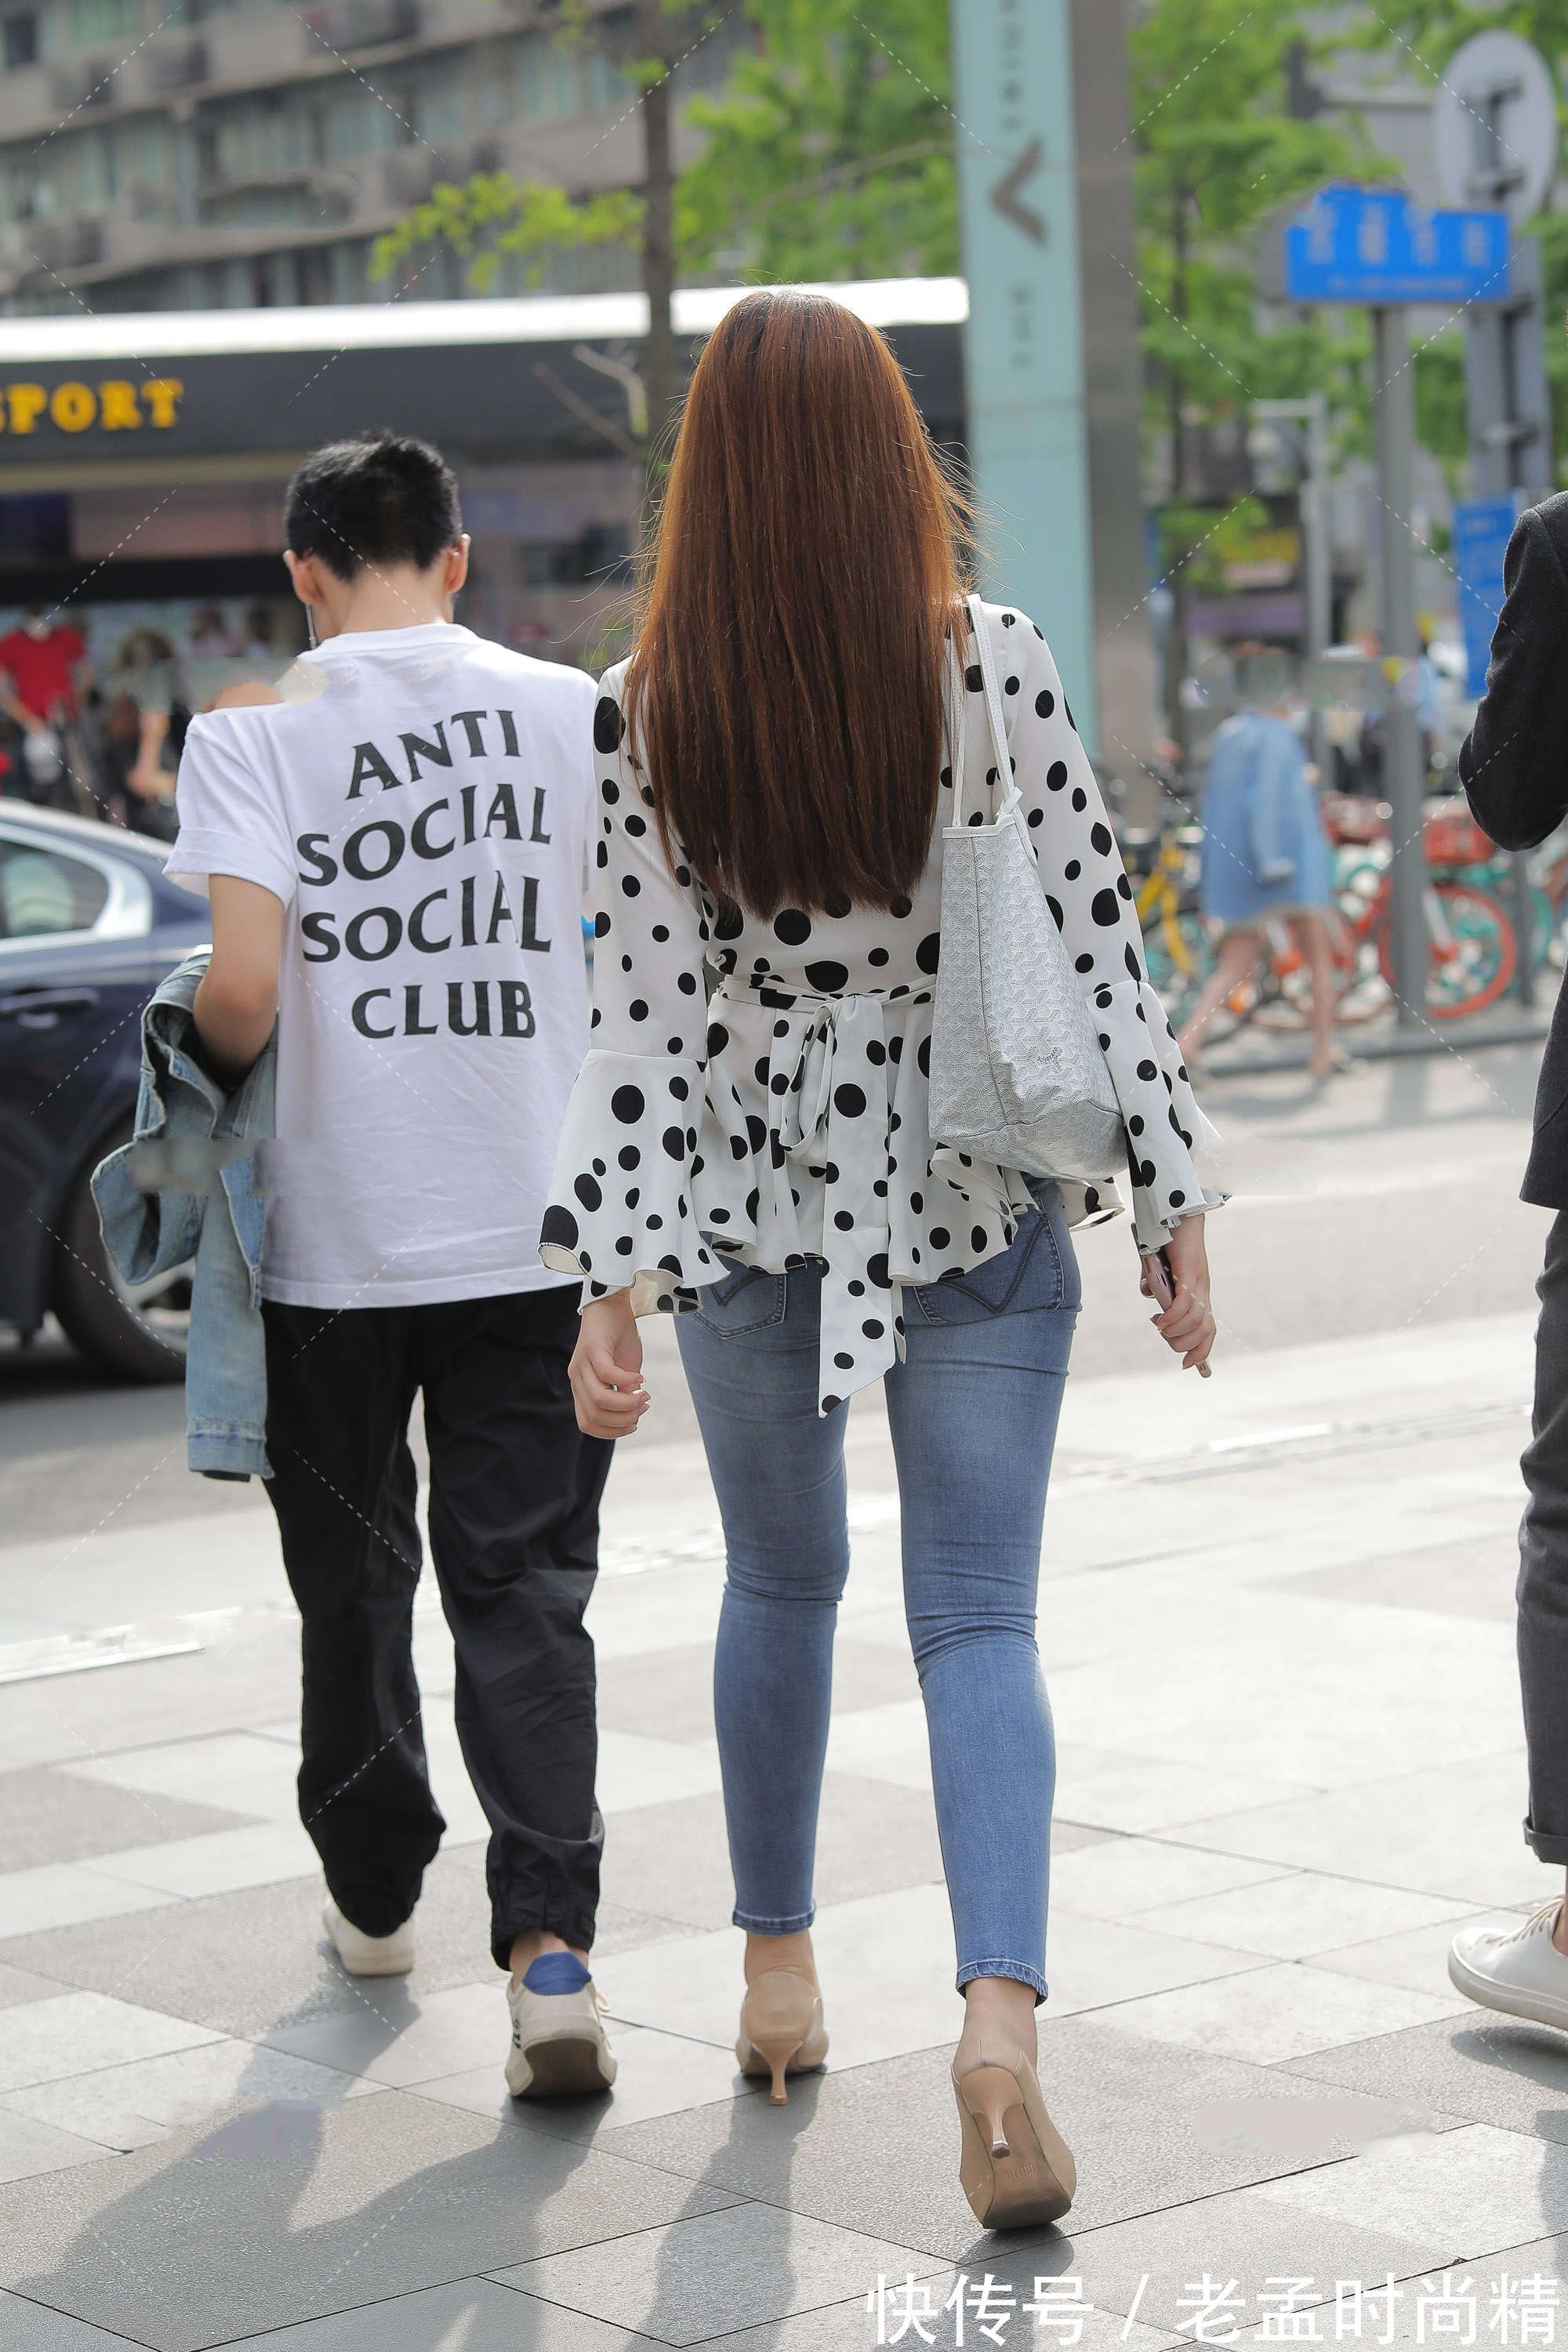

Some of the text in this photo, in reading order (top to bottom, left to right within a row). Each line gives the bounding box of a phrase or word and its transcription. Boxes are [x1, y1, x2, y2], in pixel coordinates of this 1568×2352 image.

[0, 378, 183, 434] PORT
[346, 710, 521, 800] ANTI
[296, 782, 551, 887] SOCIAL
[301, 870, 551, 963] SOCIAL
[351, 980, 536, 1039] CLUB
